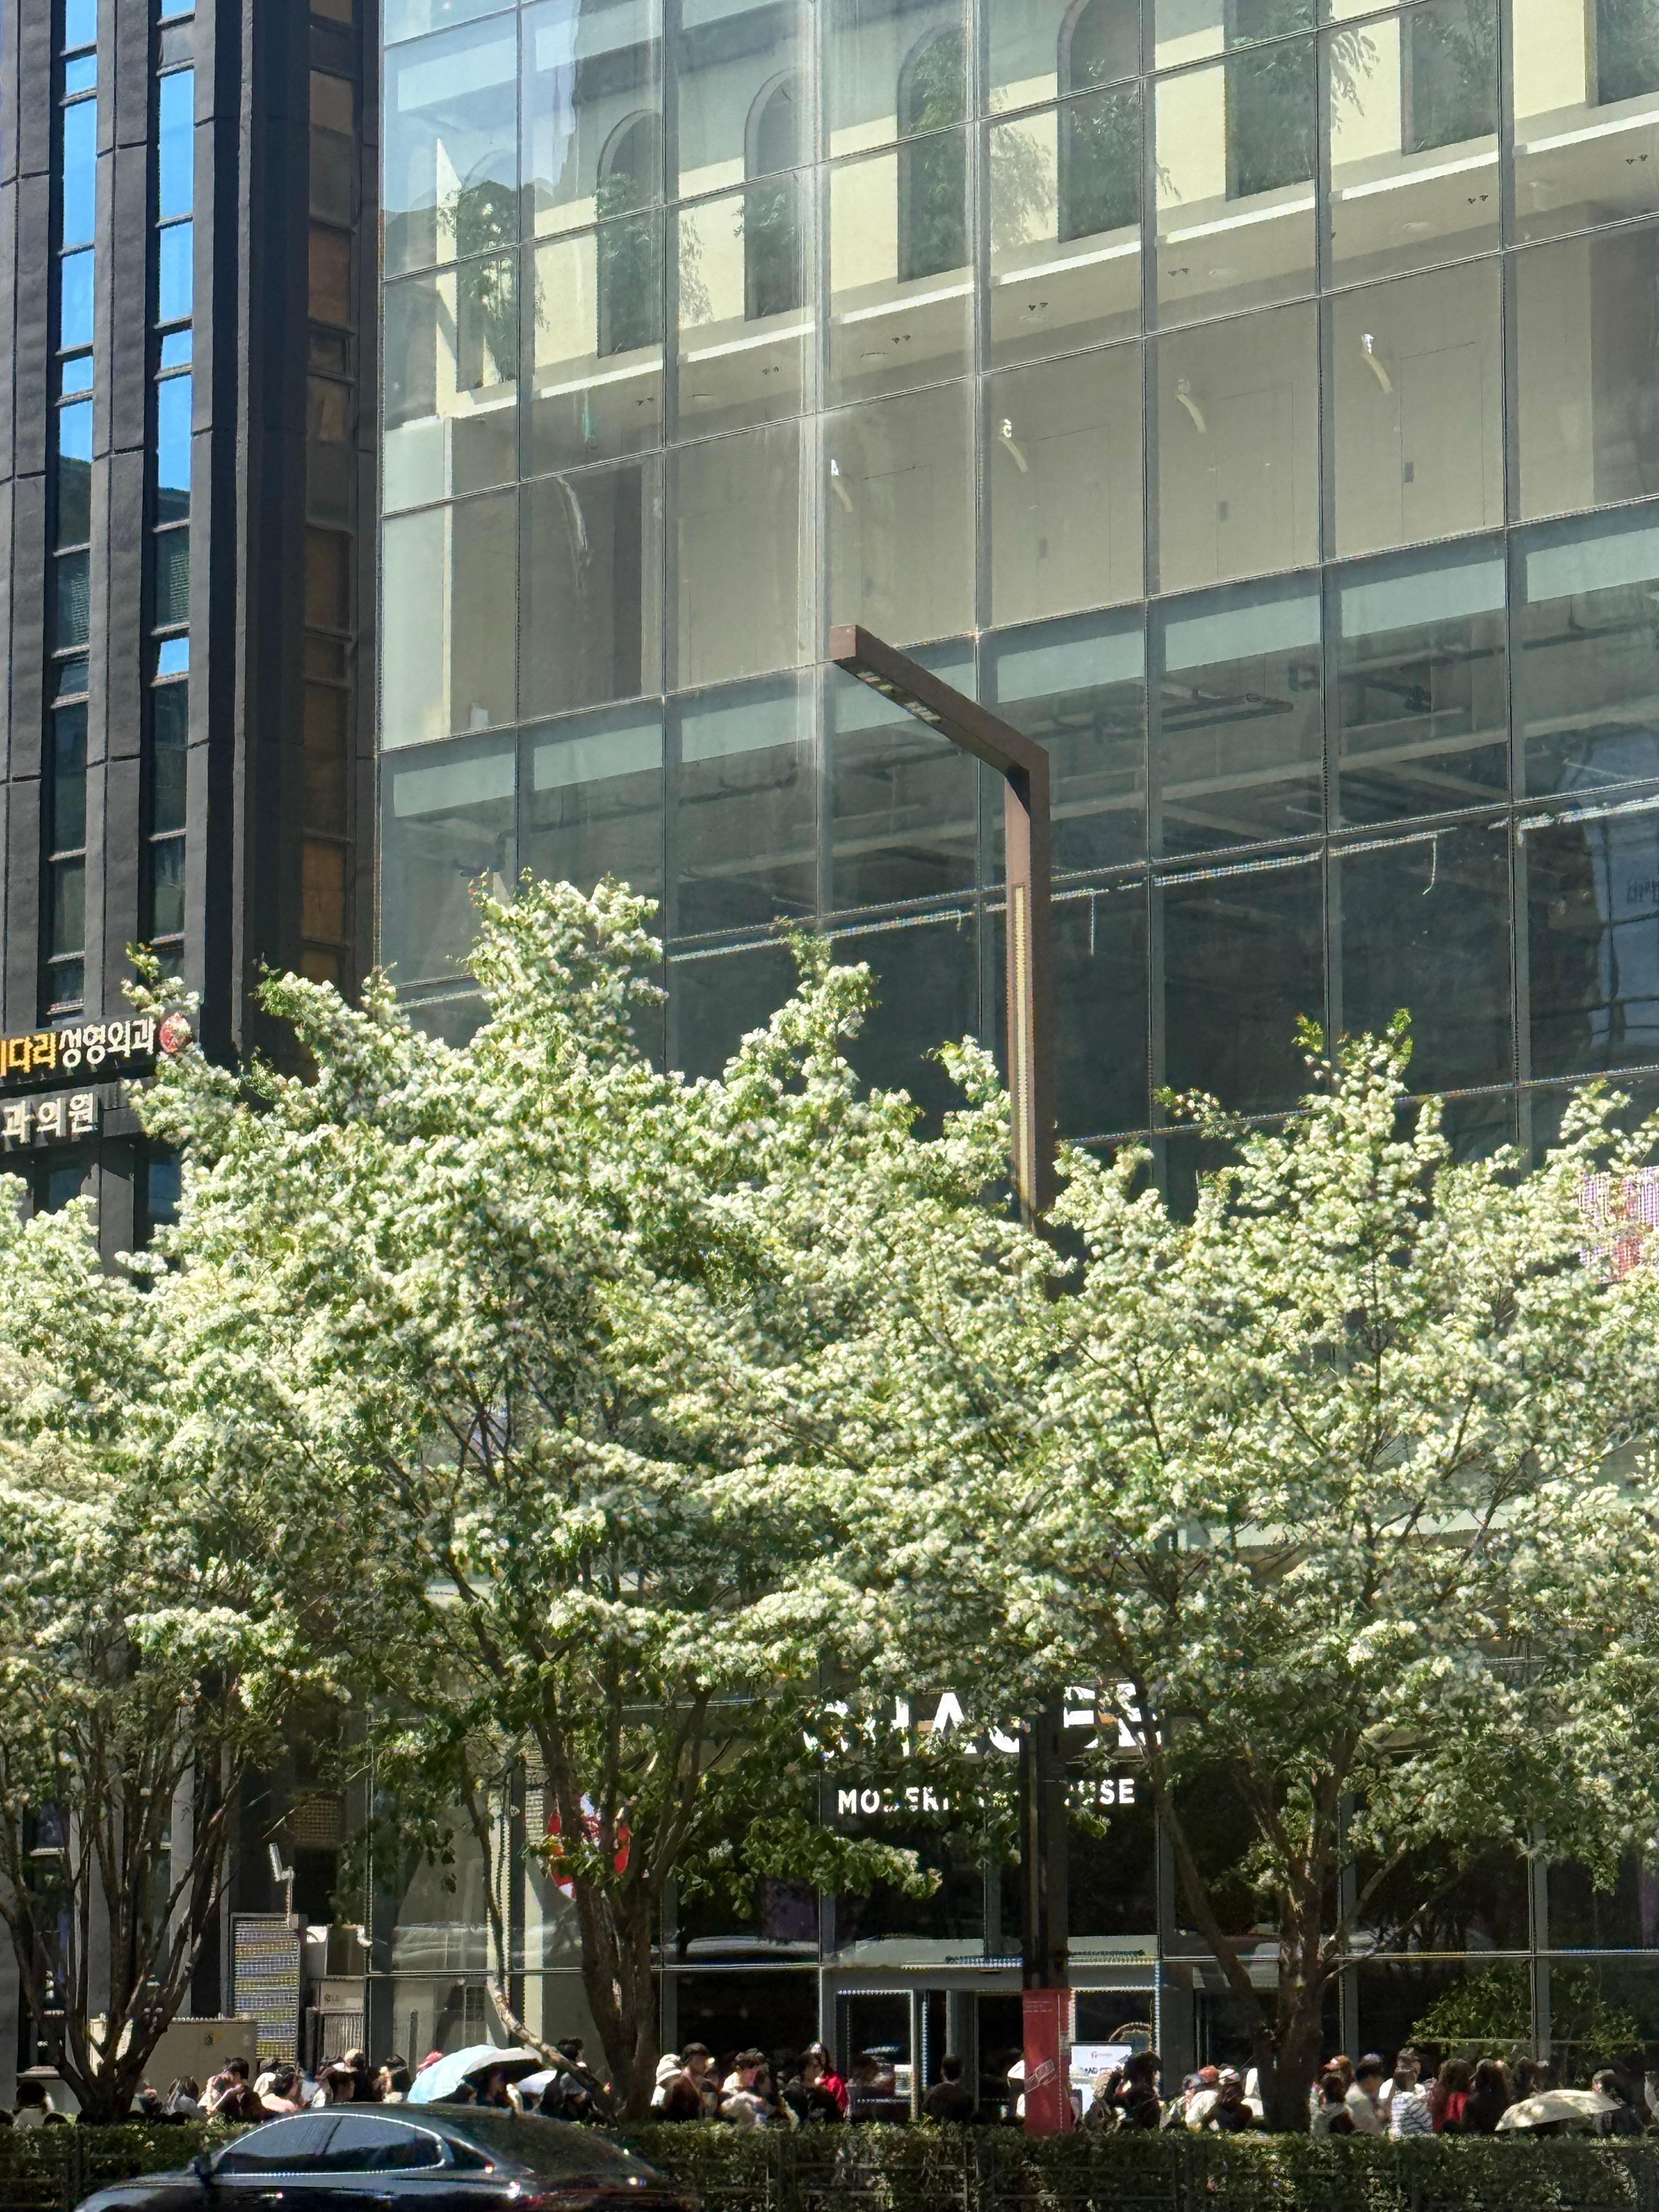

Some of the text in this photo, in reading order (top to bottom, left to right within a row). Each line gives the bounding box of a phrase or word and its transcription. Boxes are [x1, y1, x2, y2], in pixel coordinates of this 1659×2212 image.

[59, 1016, 156, 1068] 성형외과
[1, 1092, 97, 1144] 과의원
[838, 1786, 961, 1814] MOER
